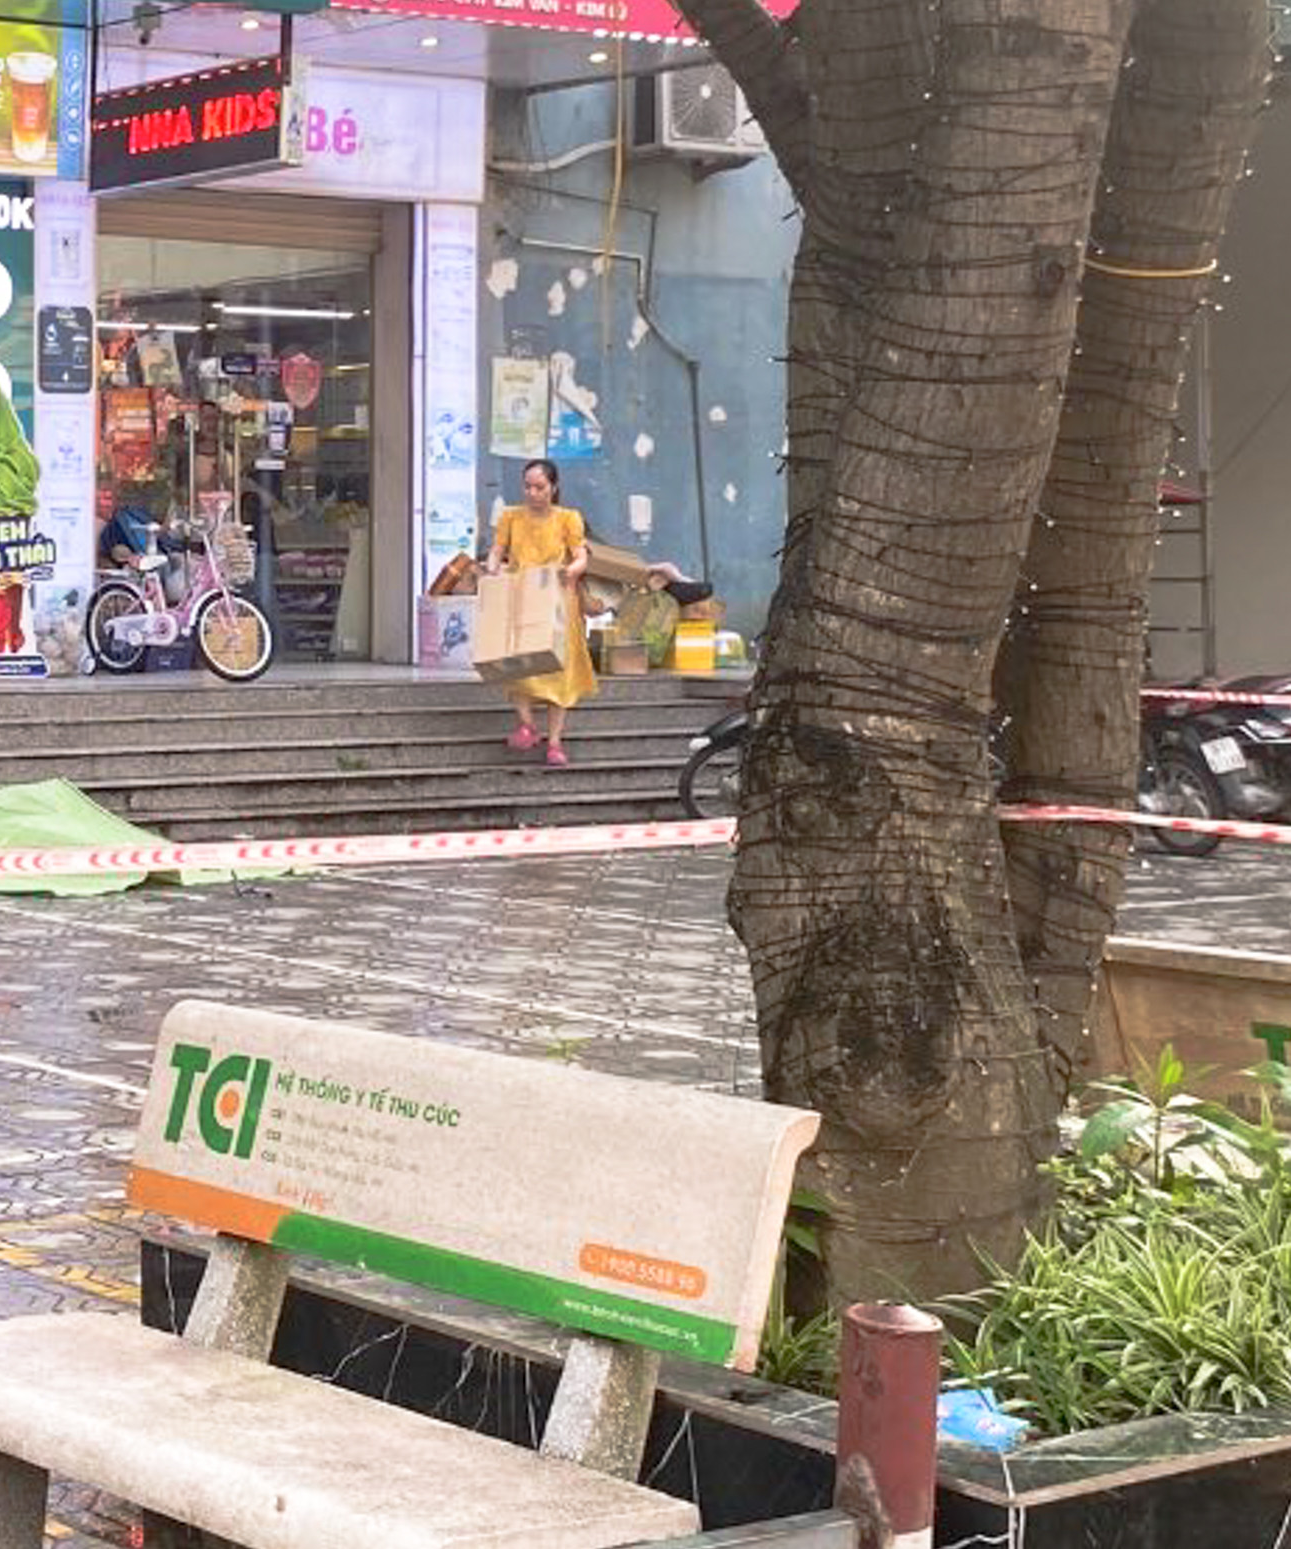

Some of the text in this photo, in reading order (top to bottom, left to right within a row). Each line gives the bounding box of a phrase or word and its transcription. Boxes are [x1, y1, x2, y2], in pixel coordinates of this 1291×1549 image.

[202, 88, 277, 141] KIDS
[306, 106, 357, 155] Bé
[164, 1043, 272, 1160] TCI
